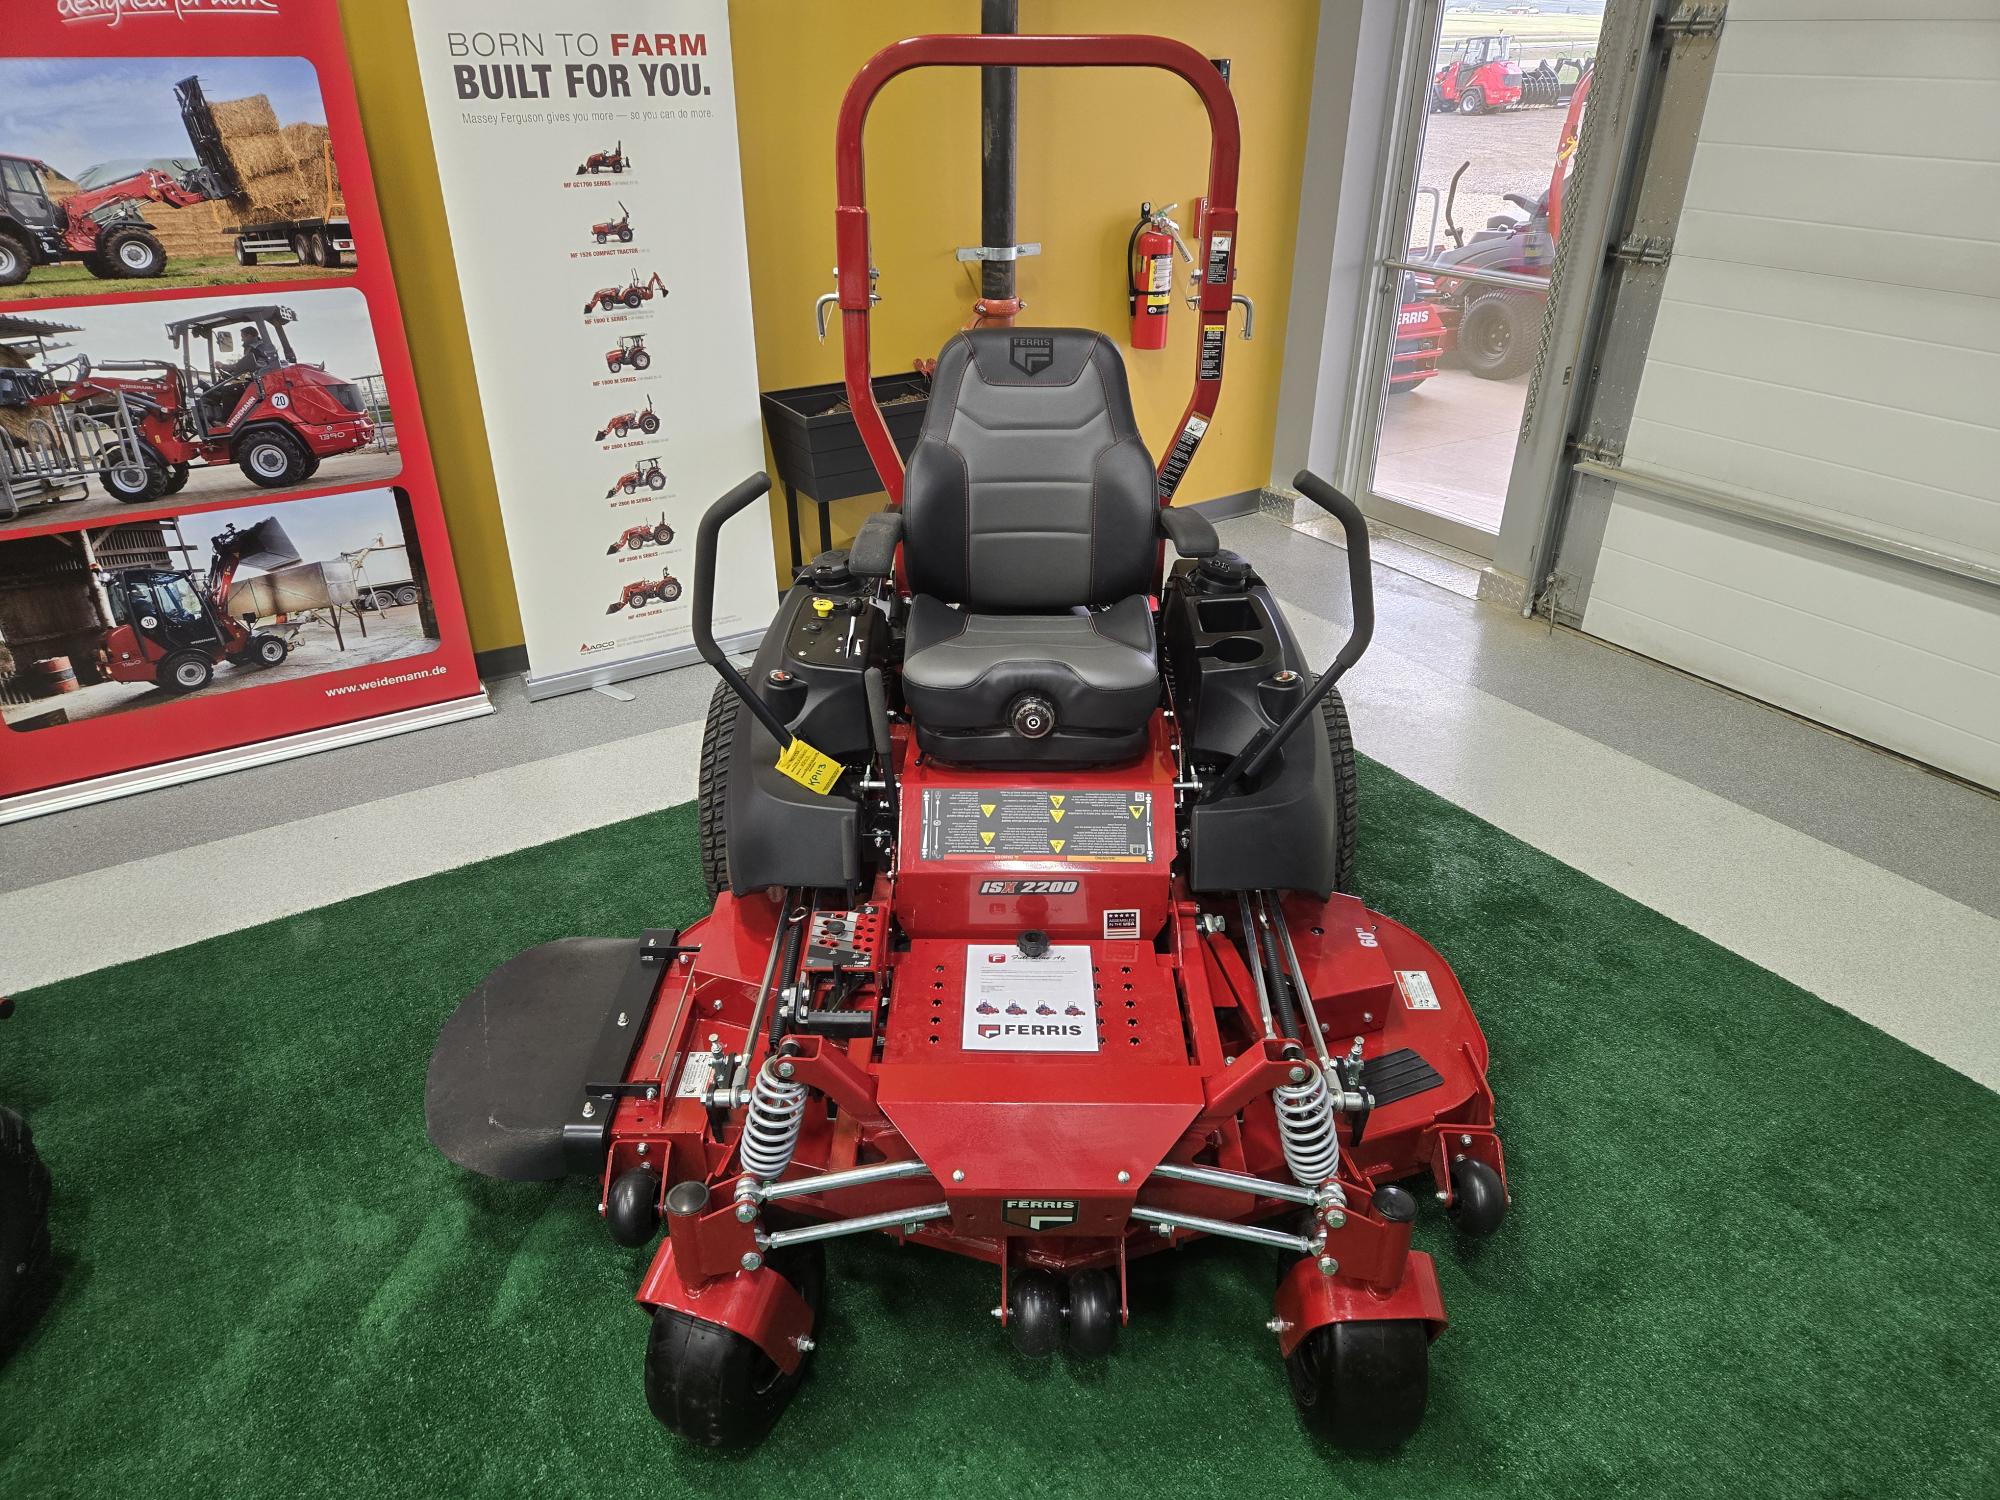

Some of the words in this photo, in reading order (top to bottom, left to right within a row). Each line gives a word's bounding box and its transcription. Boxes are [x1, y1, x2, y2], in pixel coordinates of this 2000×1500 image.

[448, 33, 545, 57] BORN
[555, 33, 599, 57] TO
[610, 33, 708, 57] FARM
[453, 63, 552, 100] BUILT
[565, 63, 632, 98] FOR
[638, 63, 711, 97] YOU.
[462, 112, 498, 126] Massey
[501, 112, 544, 126] Ferguson
[546, 111, 571, 124] gives
[573, 112, 589, 124] you
[591, 111, 614, 121] more
[630, 111, 641, 120] so
[643, 111, 658, 122] you
[659, 110, 675, 119] can
[677, 108, 689, 119] do
[690, 108, 715, 119] more.
[593, 249, 616, 257] COMPACT
[1397, 310, 1429, 325] ERRIS
[1013, 338, 1050, 346] FERRIS
[275, 395, 286, 406] 20
[227, 396, 256, 429] WEIDEMANN
[319, 431, 345, 440] 1390
[643, 551, 659, 559] SERIES
[143, 618, 154, 627] 30
[590, 640, 615, 650] AGCO
[325, 665, 447, 697] www.weidemann.de
[981, 881, 1018, 894] ISX
[1021, 881, 1078, 894] 2200
[1005, 1024, 1082, 1036] FERRIS
[1007, 1201, 1075, 1209] FERRIS
